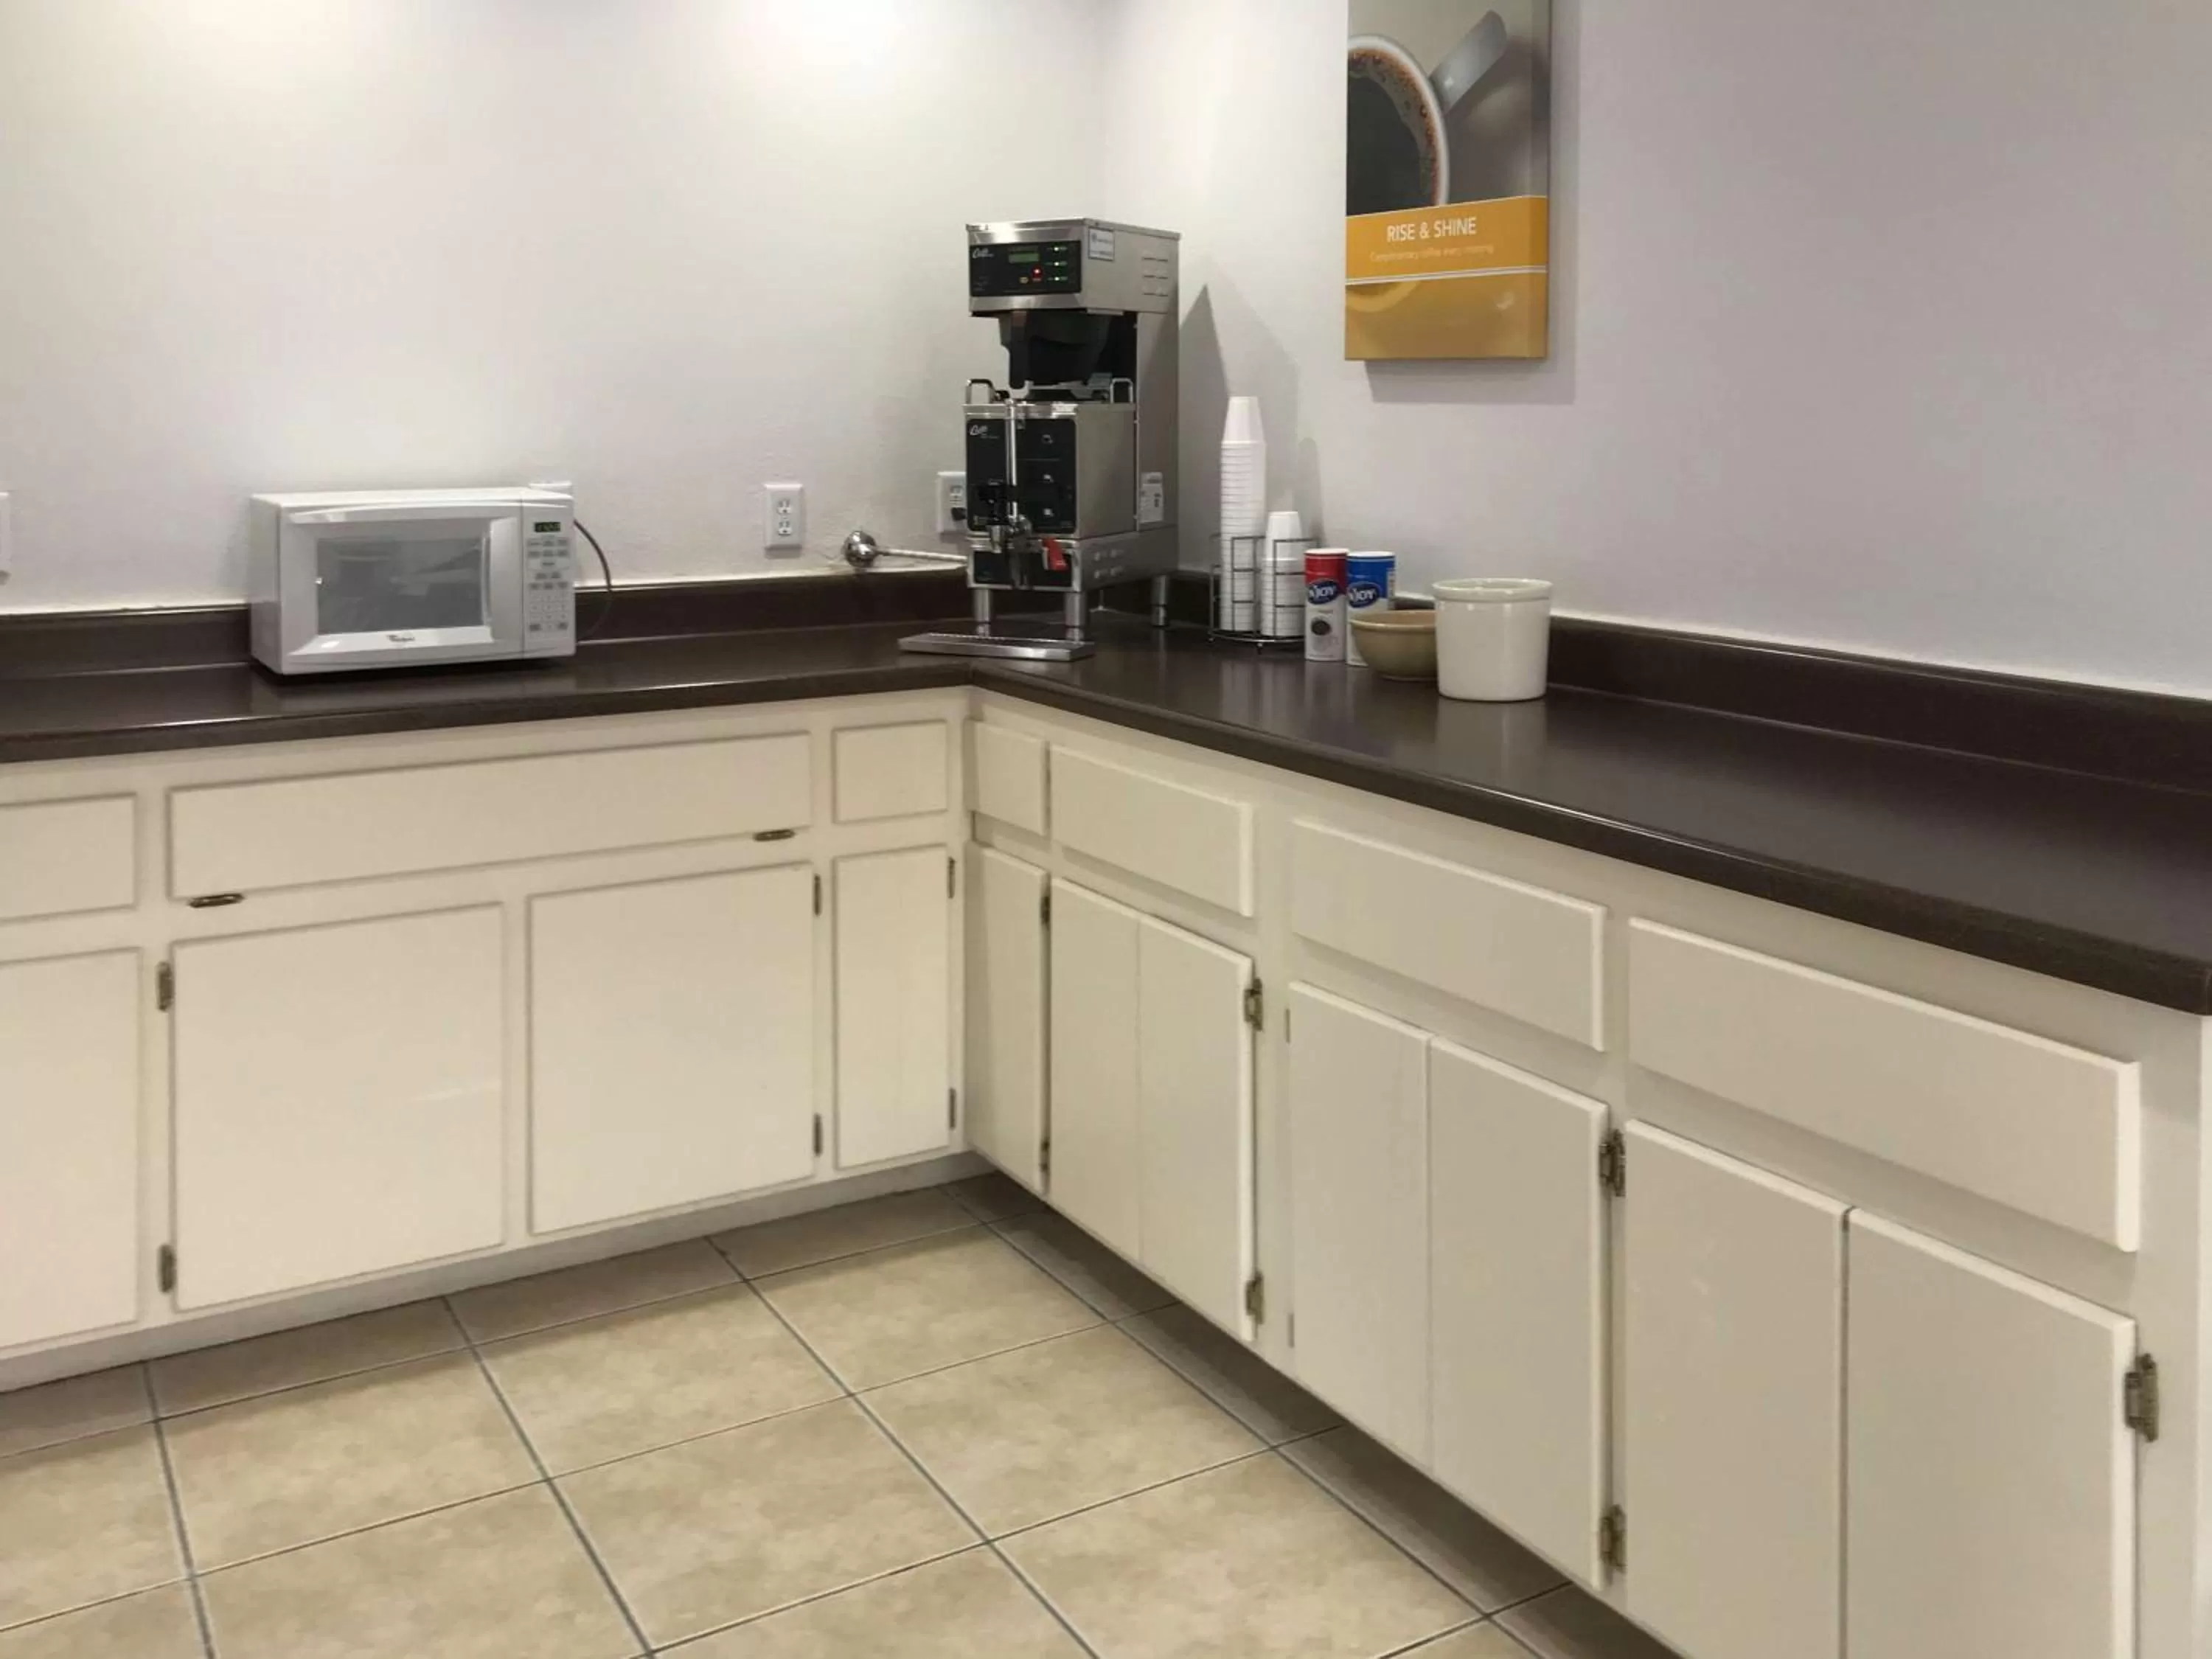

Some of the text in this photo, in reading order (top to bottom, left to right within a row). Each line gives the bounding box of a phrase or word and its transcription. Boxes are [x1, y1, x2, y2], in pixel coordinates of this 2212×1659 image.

[1386, 216, 1477, 242] RISE & SHINE
